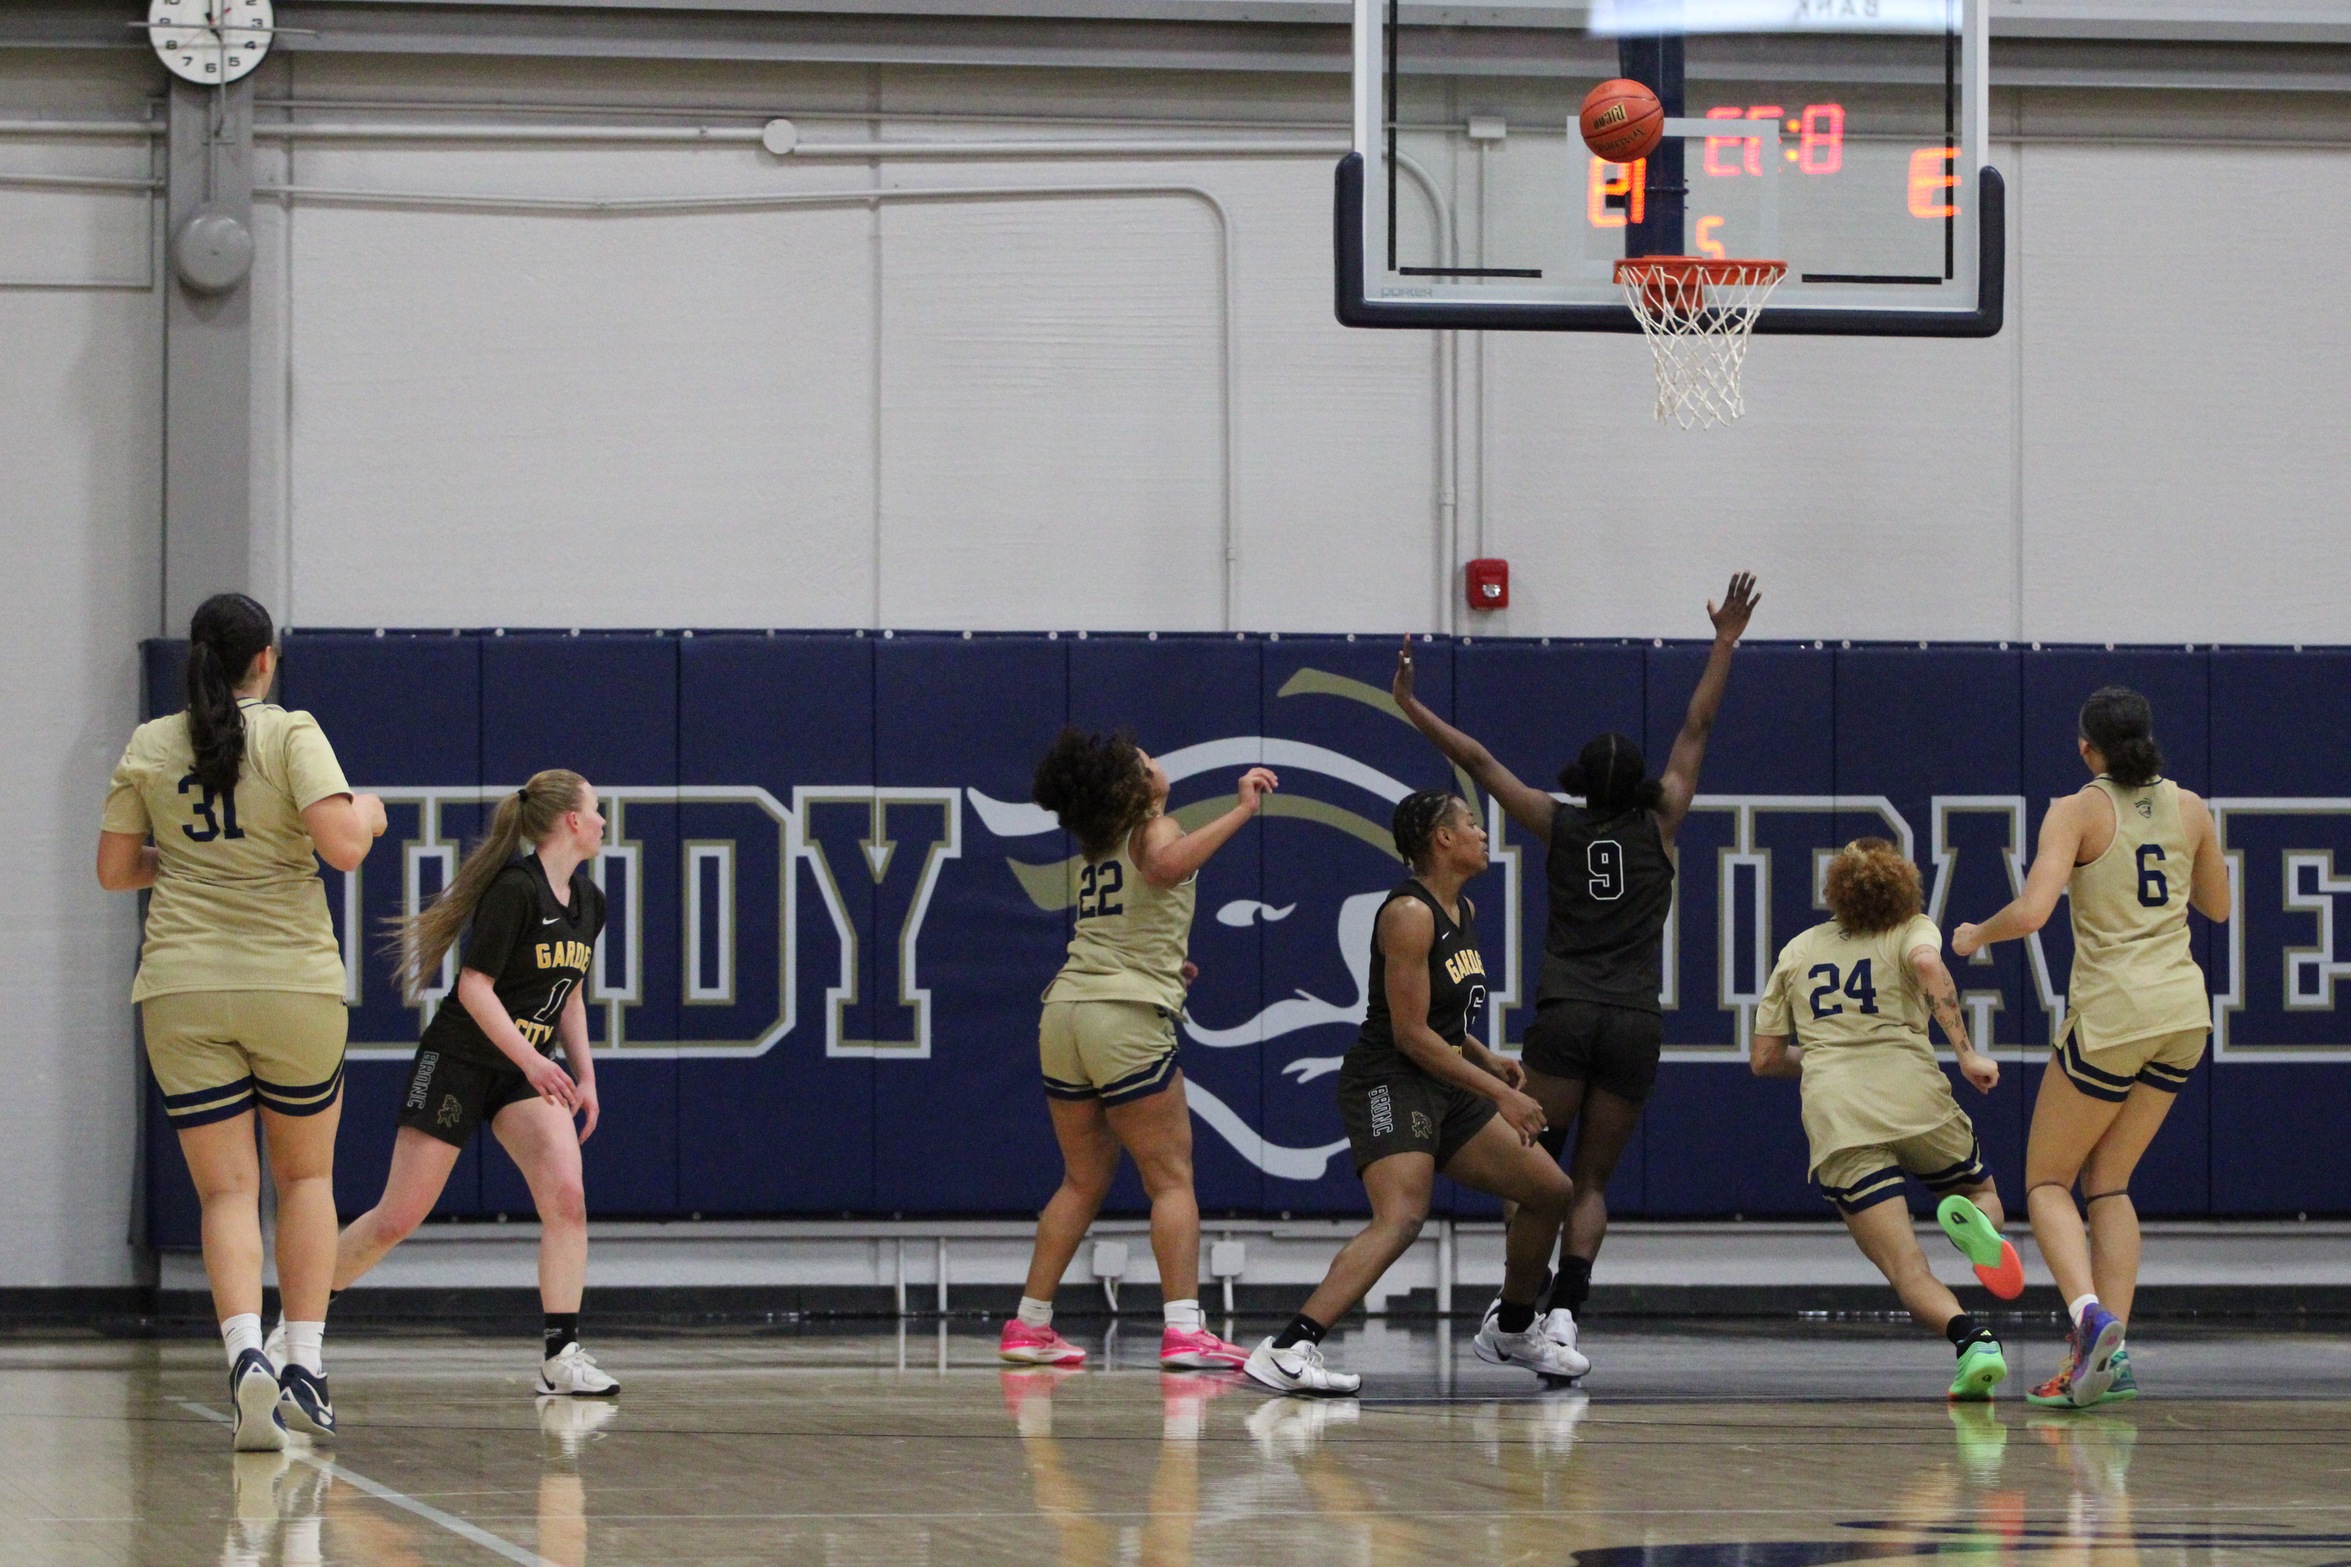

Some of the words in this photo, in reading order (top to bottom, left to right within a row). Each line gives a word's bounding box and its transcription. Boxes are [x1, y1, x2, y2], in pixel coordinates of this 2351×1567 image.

[165, 40, 178, 50] 8
[244, 40, 257, 50] 4
[251, 18, 264, 29] 3
[182, 56, 194, 67] 7
[205, 63, 217, 73] 6
[228, 56, 241, 67] 5
[178, 774, 245, 842] 31
[1079, 860, 1124, 918] 22
[1587, 839, 1625, 901] 9
[2136, 843, 2169, 909] 6
[533, 978, 573, 1022] 1
[1807, 957, 1880, 1020] 24
[407, 1051, 440, 1110] BRONC
[1368, 1084, 1394, 1138] BRONC
